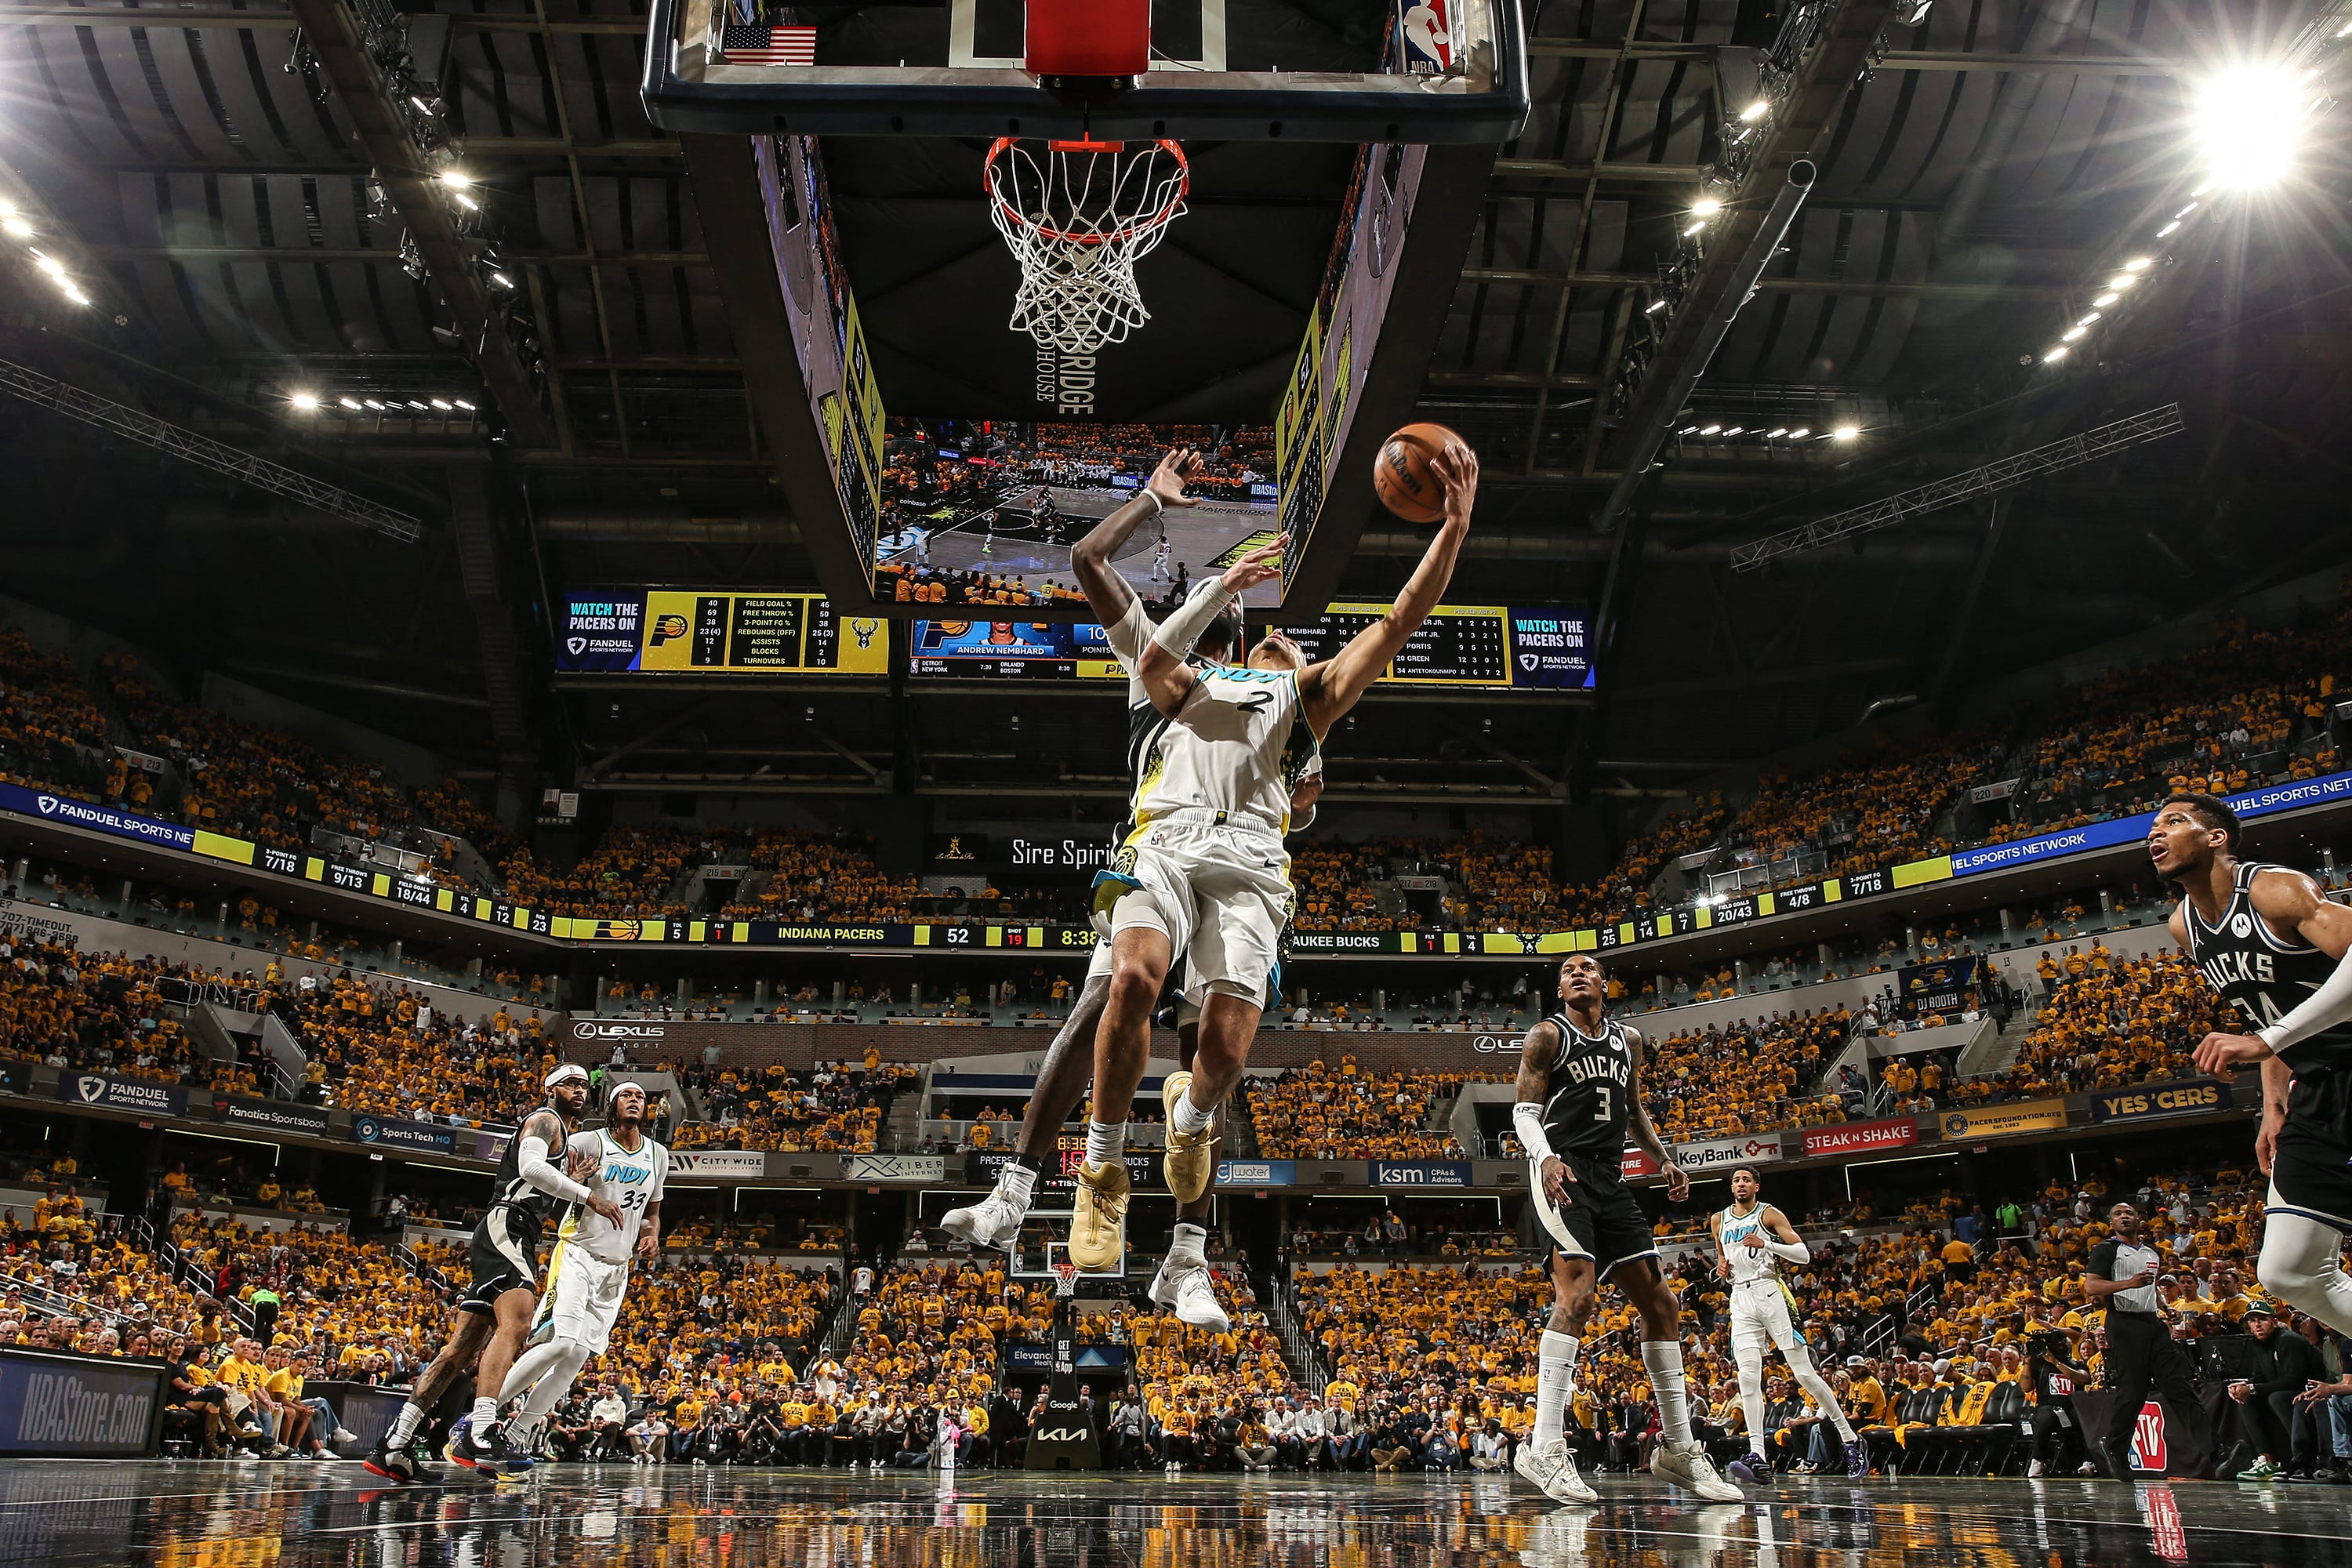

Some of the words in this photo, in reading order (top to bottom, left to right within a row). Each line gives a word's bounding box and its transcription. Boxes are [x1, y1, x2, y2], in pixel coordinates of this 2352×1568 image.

[1411, 61, 1435, 73] NBA
[570, 603, 612, 616] WATCH
[615, 603, 639, 616] THE
[569, 617, 615, 631] PACERS
[618, 618, 636, 631] ON
[1515, 619, 1558, 633] WATCH
[1559, 620, 1584, 633] THE
[771, 629, 796, 638] (OFF)
[1087, 627, 1105, 640] 10
[590, 639, 634, 648] FANDUEL
[1519, 633, 1564, 648] PACERS
[1566, 634, 1584, 648] ON
[957, 646, 995, 655] ANDREW
[996, 646, 1045, 655] NEMBHARD
[743, 657, 786, 666] TURNOVERS
[1542, 656, 1586, 665] FANDUEL
[1236, 691, 1275, 714] 2
[1975, 789, 1991, 800] 220
[2260, 785, 2319, 806] SPORTS
[60, 804, 122, 828] FANDUEL
[123, 818, 172, 840] SPORTS
[266, 848, 289, 859] 3-POINT
[1013, 839, 1054, 864] Sire
[1062, 840, 1111, 870] Spiri
[1972, 847, 2020, 866] SPORTS
[2023, 833, 2086, 856] NETWORK
[265, 855, 296, 873] 7/18
[331, 864, 345, 873] FREE
[345, 867, 368, 878] THROWS
[706, 868, 719, 877] 215
[334, 872, 363, 888] 9/13
[1399, 880, 1411, 888] 217
[1425, 880, 1437, 888] 218
[1850, 874, 1873, 884] 3-POINT
[398, 880, 413, 889] FIELD
[413, 884, 430, 893] GOALS
[1794, 886, 1817, 896] THROWS
[1851, 880, 1882, 896] 7/18
[397, 887, 430, 905] 18/44
[1789, 895, 1810, 908] 4/8
[496, 911, 510, 924] 12
[1718, 906, 1752, 923] 20/43
[2, 911, 73, 933] 707-TIMEOUT.
[532, 920, 546, 932] 23
[779, 927, 831, 939] INDIANA
[834, 929, 884, 940] PACERS
[947, 928, 969, 943] 52
[1062, 931, 1097, 945] 8:38
[1639, 927, 1653, 938] 14
[1007, 935, 1022, 945] 19
[1292, 936, 1334, 947] AUKEE
[1336, 936, 1380, 948] BUCKS
[1602, 934, 1616, 946] 25
[1917, 998, 1927, 1011] DJ
[1929, 993, 1958, 1008] BOOTH
[2229, 991, 2285, 1034] 34
[597, 1025, 665, 1036] LEXUS
[1566, 1054, 1630, 1088] BUCKS
[110, 1083, 169, 1101] FANDUEL
[109, 1094, 136, 1105] SPORTS
[135, 1098, 169, 1109] NETWORK
[1594, 1087, 1611, 1121] 3
[2103, 1096, 2148, 1116] YES
[2151, 1086, 2219, 1110] 'CERS
[228, 1105, 270, 1121] Fanatics
[270, 1112, 325, 1129] Sportsbook
[1969, 1111, 2061, 1127] PACERSFOUNDATION.org
[382, 1127, 412, 1141] Sports
[413, 1131, 434, 1142] Tech
[436, 1134, 451, 1145] HQ
[1806, 1133, 1850, 1149] STEAK
[1863, 1126, 1911, 1142] SHAKE
[1058, 1138, 1088, 1150] 8:38
[980, 1156, 1013, 1165] PACERS
[1124, 1157, 1149, 1166] BUCKS
[1679, 1146, 1743, 1167] KeyBank
[895, 1160, 944, 1171] XIBER
[1234, 1167, 1269, 1177] water
[604, 1163, 650, 1185] INDY
[1134, 1171, 1147, 1180] 51
[1379, 1163, 1424, 1183] ksm
[620, 1190, 647, 1211] 33
[1725, 1224, 1758, 1245] INDY
[1058, 1341, 1069, 1350] GET
[1058, 1351, 1070, 1361] THE
[1061, 1363, 1073, 1374] App
[2060, 1380, 2072, 1392] TV
[17, 1372, 150, 1445] NBAStore.com
[1050, 1400, 1078, 1410] Google
[1037, 1428, 1087, 1441] KIA
[2137, 1417, 2158, 1457] TV
